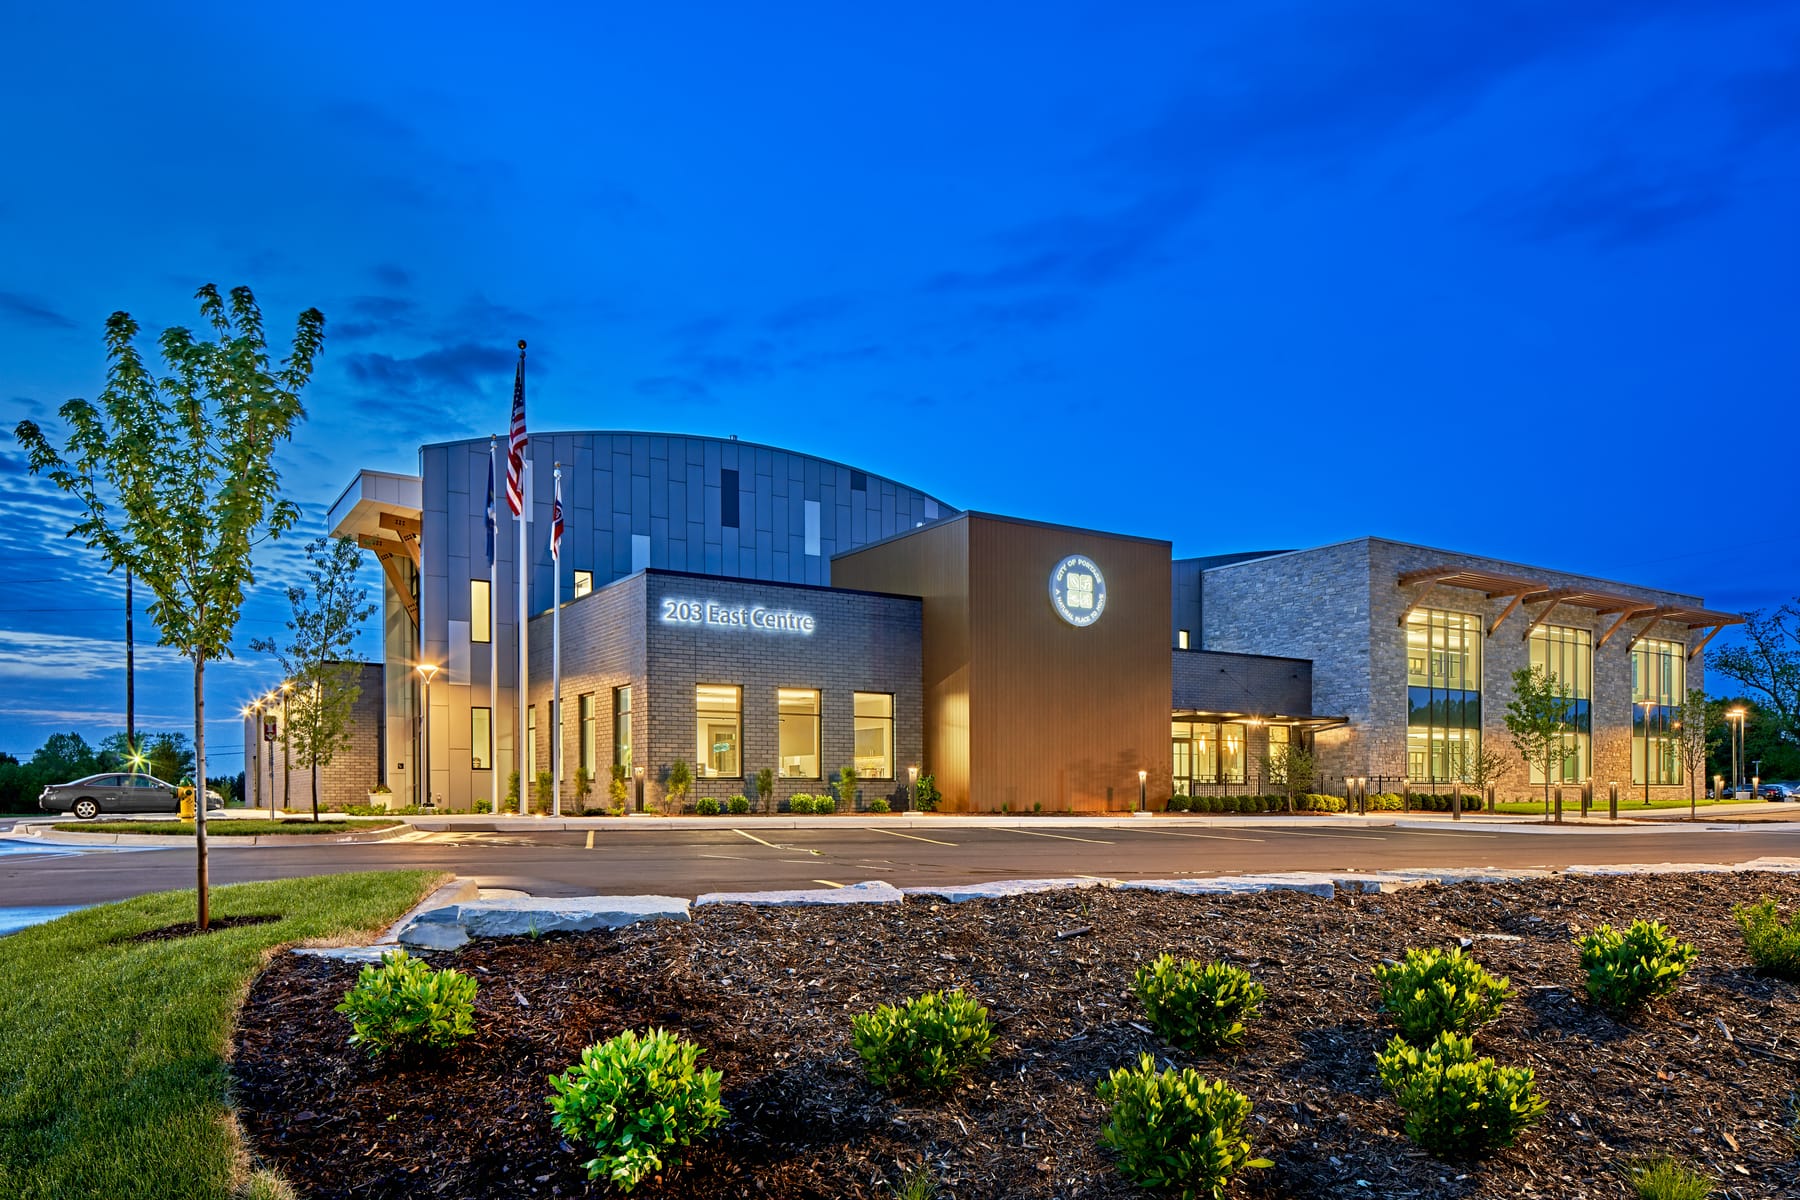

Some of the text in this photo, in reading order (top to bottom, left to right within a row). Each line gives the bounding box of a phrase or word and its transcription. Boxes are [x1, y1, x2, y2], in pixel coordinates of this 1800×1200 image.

[1057, 564, 1067, 582] CITY
[1067, 559, 1076, 567] OF
[663, 600, 815, 632] 203 East Centre
